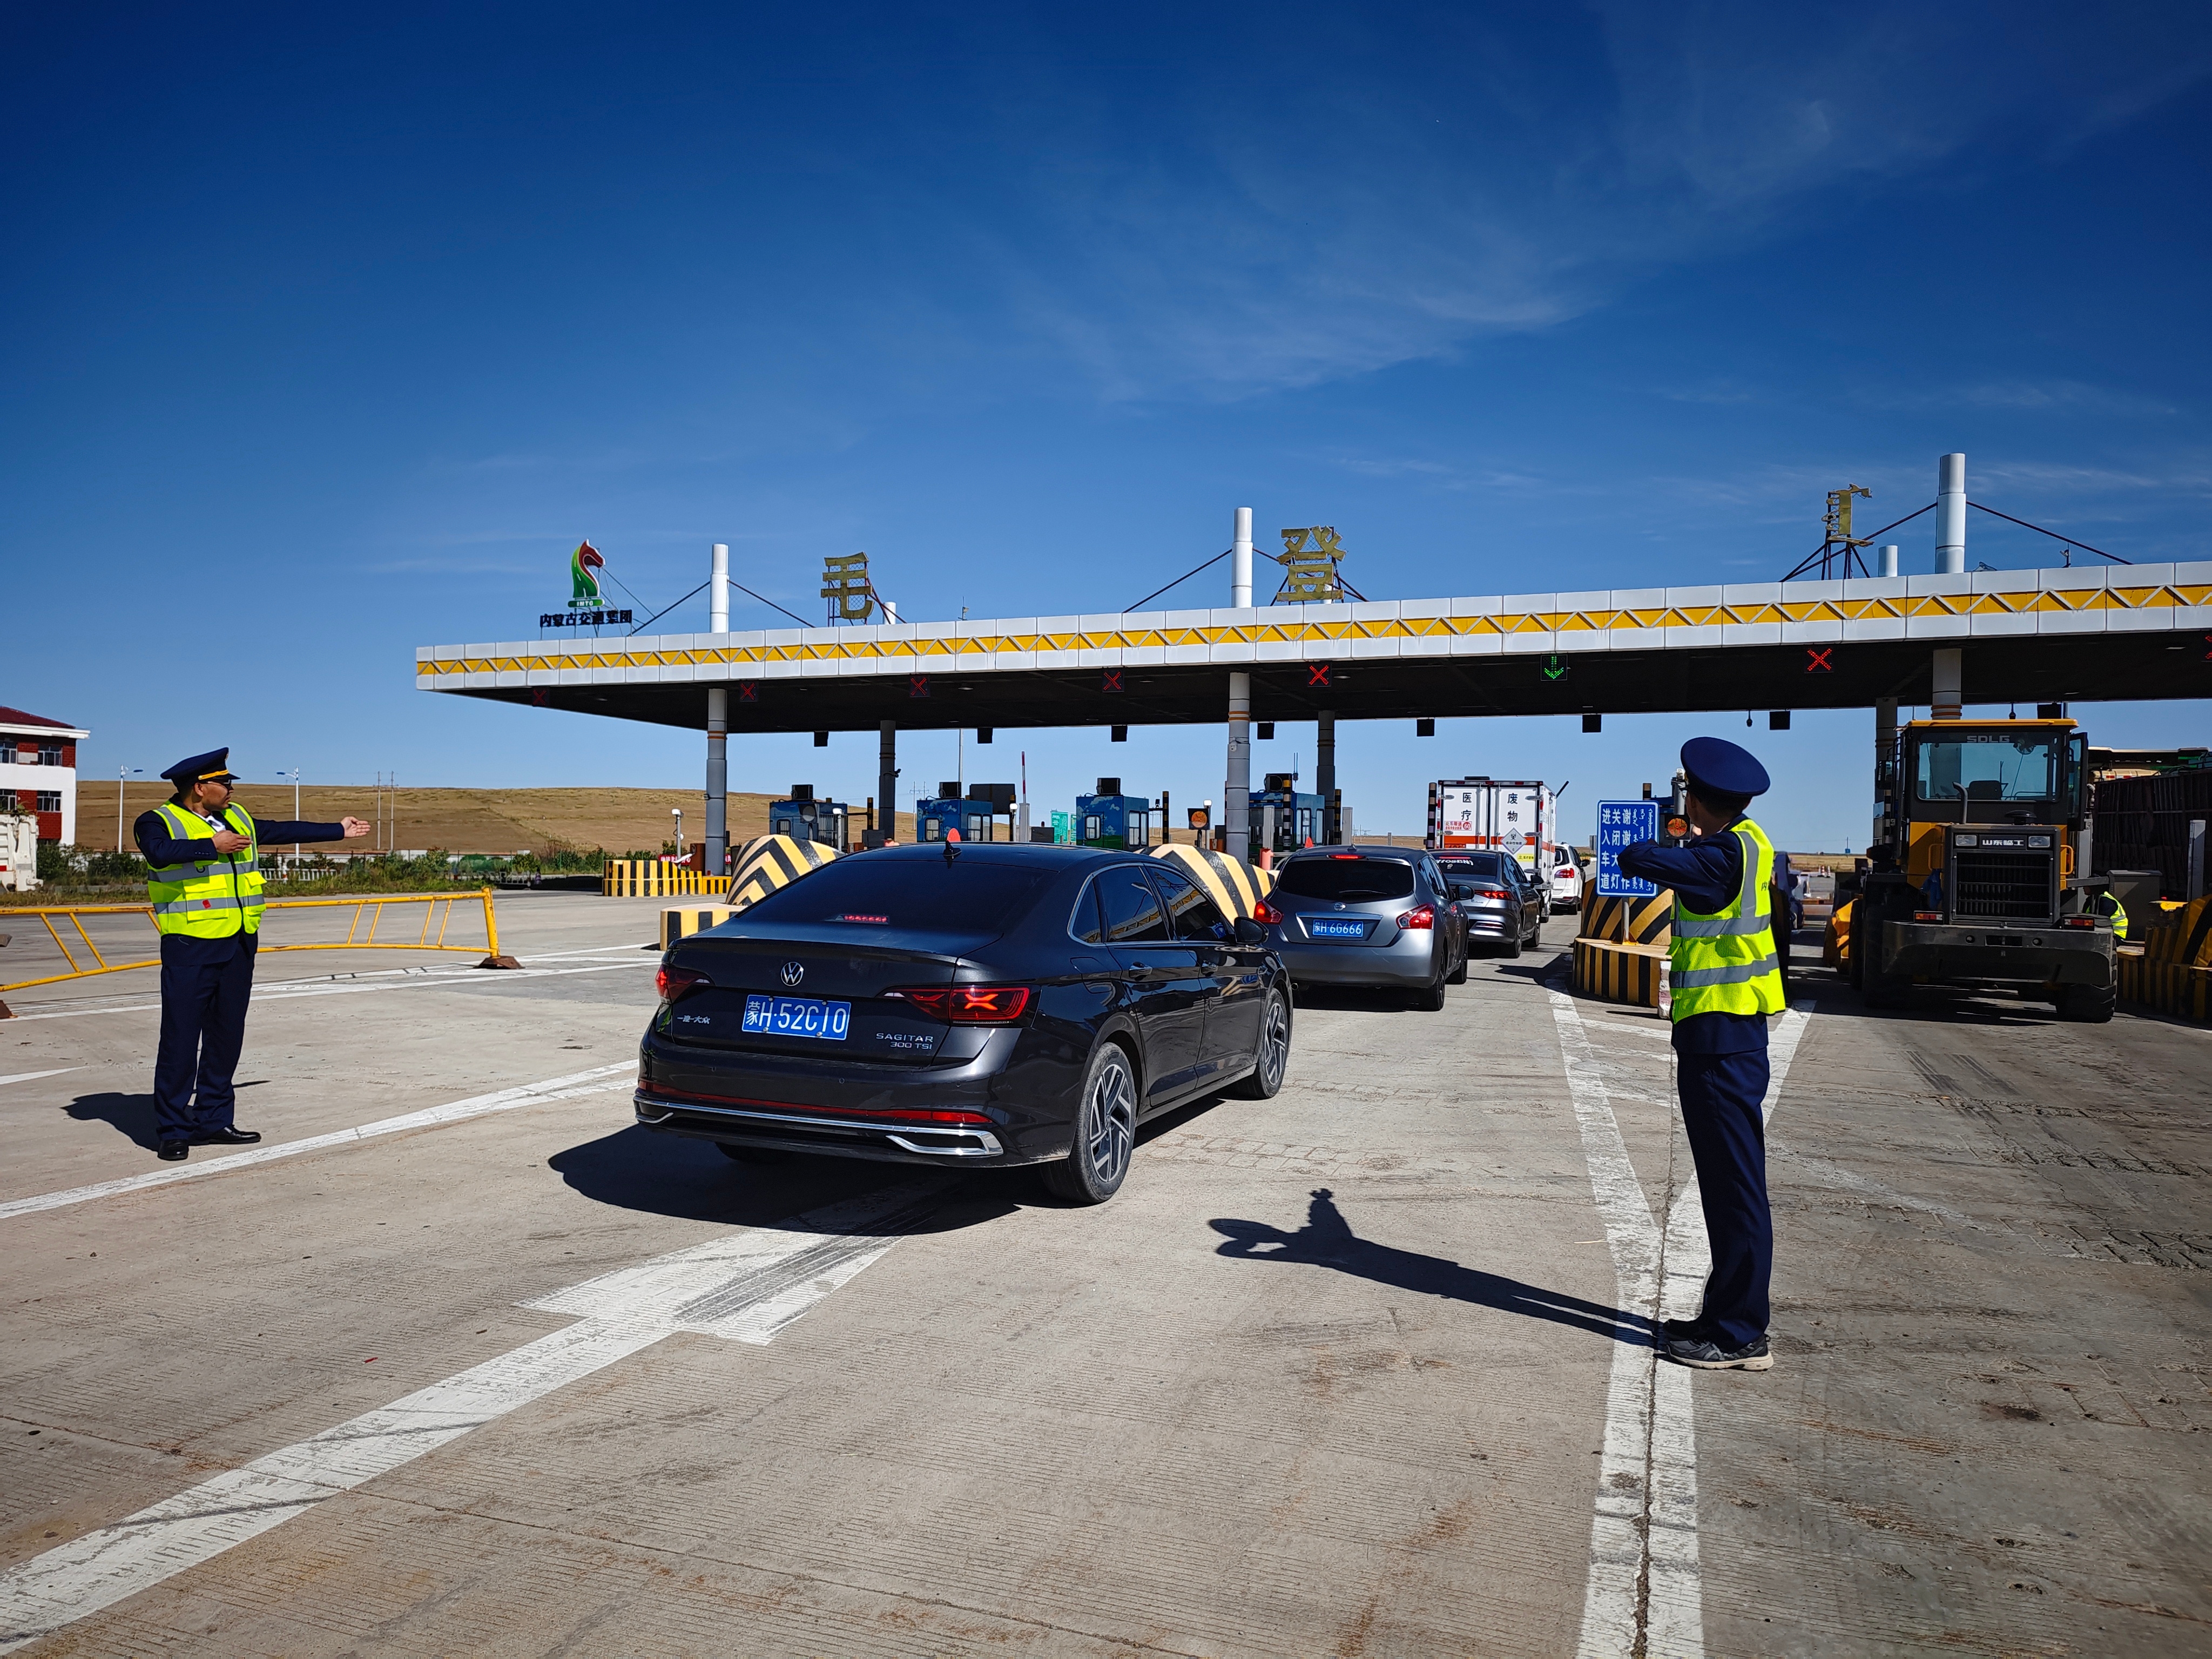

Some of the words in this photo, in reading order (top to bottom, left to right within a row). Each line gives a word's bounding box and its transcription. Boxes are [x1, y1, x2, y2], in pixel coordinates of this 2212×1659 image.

[821, 551, 874, 619] 毛
[1277, 525, 1347, 602] 登
[541, 610, 632, 627] 内蒙古交通集团
[1966, 735, 2010, 743] SDLG
[876, 1033, 933, 1043] SAGITAR
